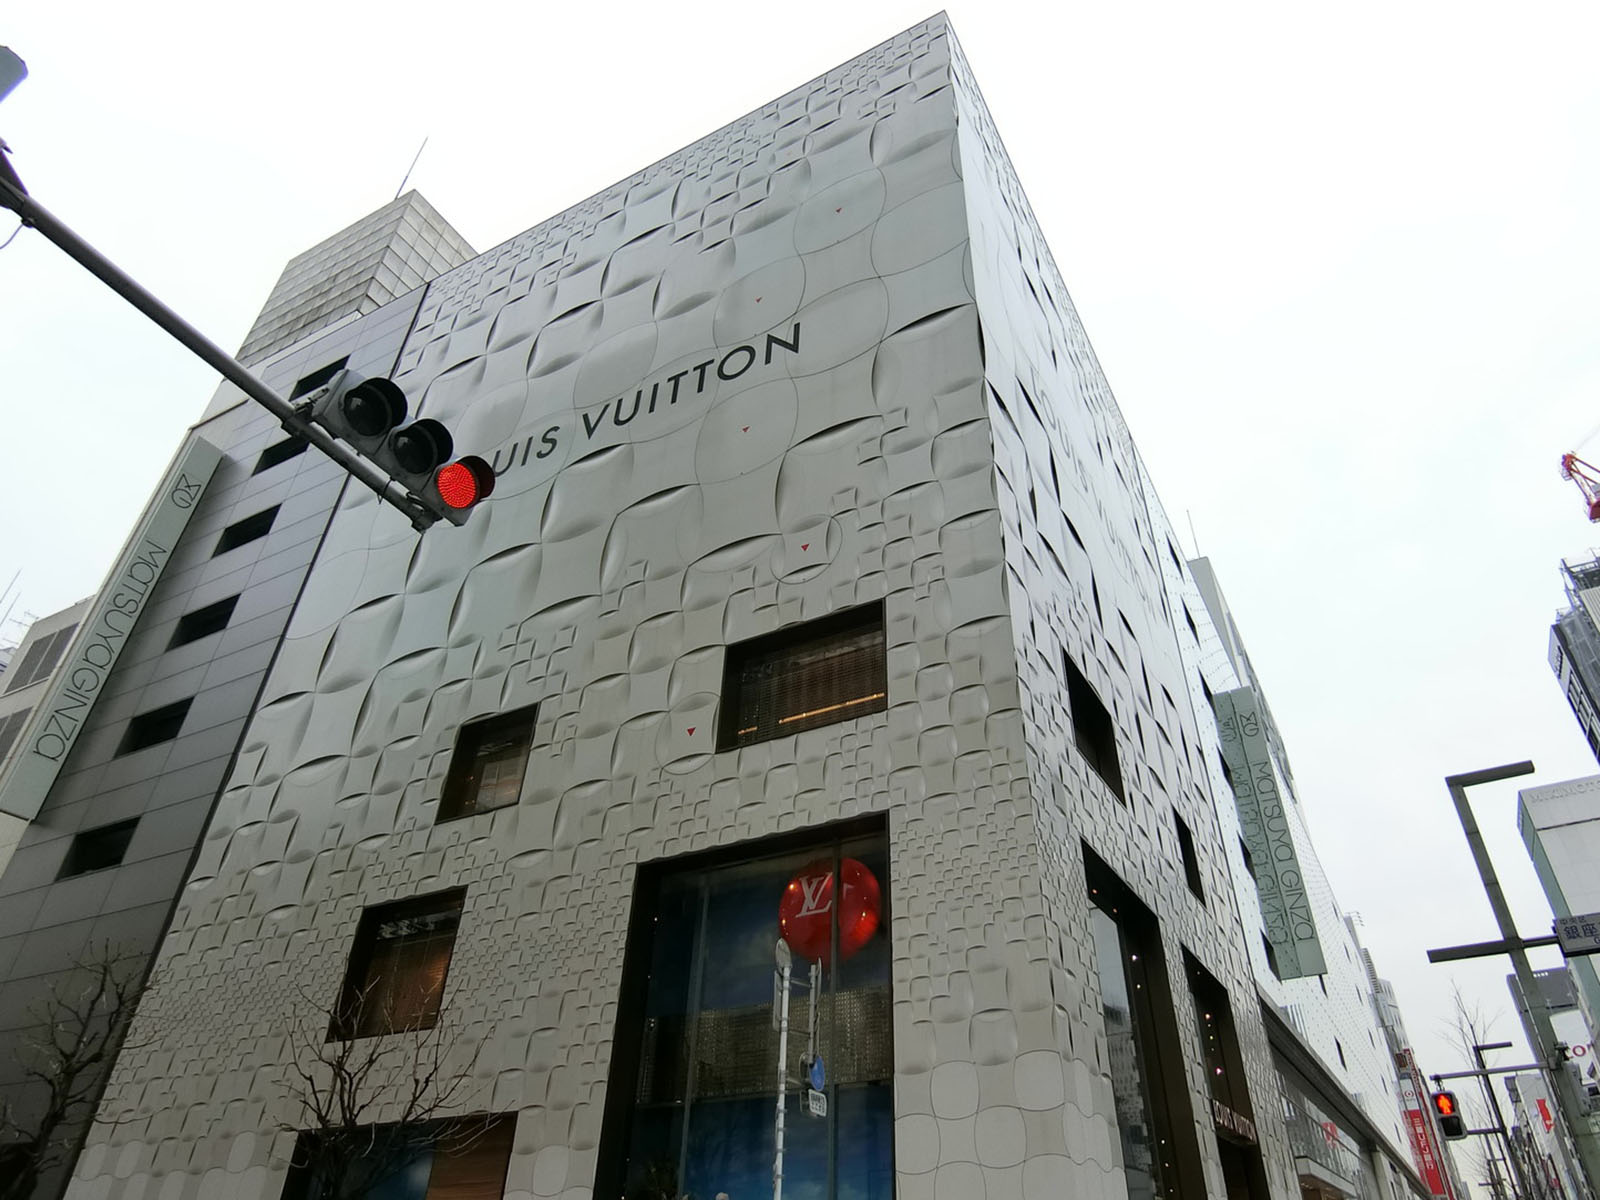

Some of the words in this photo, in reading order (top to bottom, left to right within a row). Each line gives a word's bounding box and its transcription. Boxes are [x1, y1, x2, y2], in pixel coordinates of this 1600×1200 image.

[491, 425, 561, 477] UIS
[582, 322, 800, 440] VUITTON
[795, 871, 833, 918] LV
